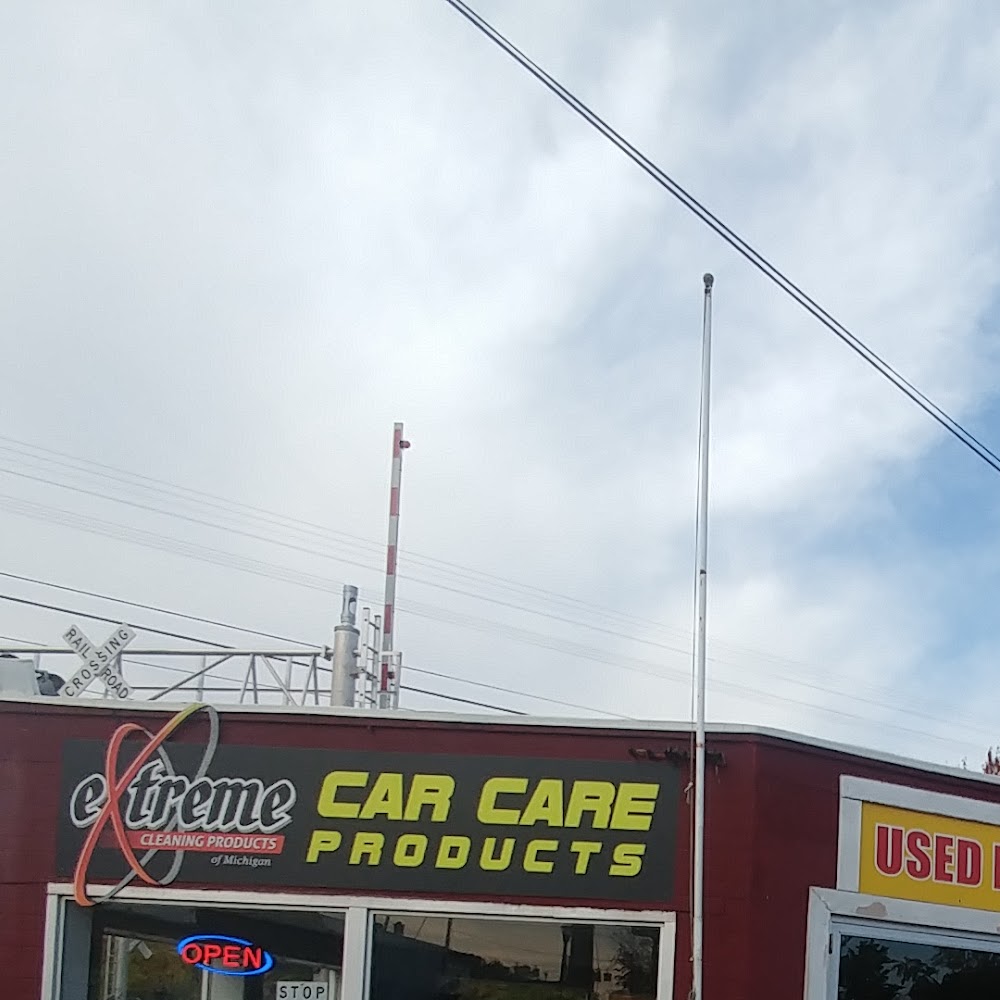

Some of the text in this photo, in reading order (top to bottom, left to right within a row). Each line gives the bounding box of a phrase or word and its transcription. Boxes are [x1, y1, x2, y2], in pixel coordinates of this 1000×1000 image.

[65, 628, 92, 659] RAIL
[64, 629, 129, 697] CROSSING
[101, 667, 129, 699] ROAD
[317, 770, 660, 832] CAR CARE
[140, 833, 277, 850] CLEANING PRODUCTS
[306, 829, 647, 877] PRODUCTS
[875, 824, 982, 886] USED
[210, 854, 272, 867] of Michigan
[181, 942, 262, 969] OPEN
[279, 985, 325, 999] STOP
